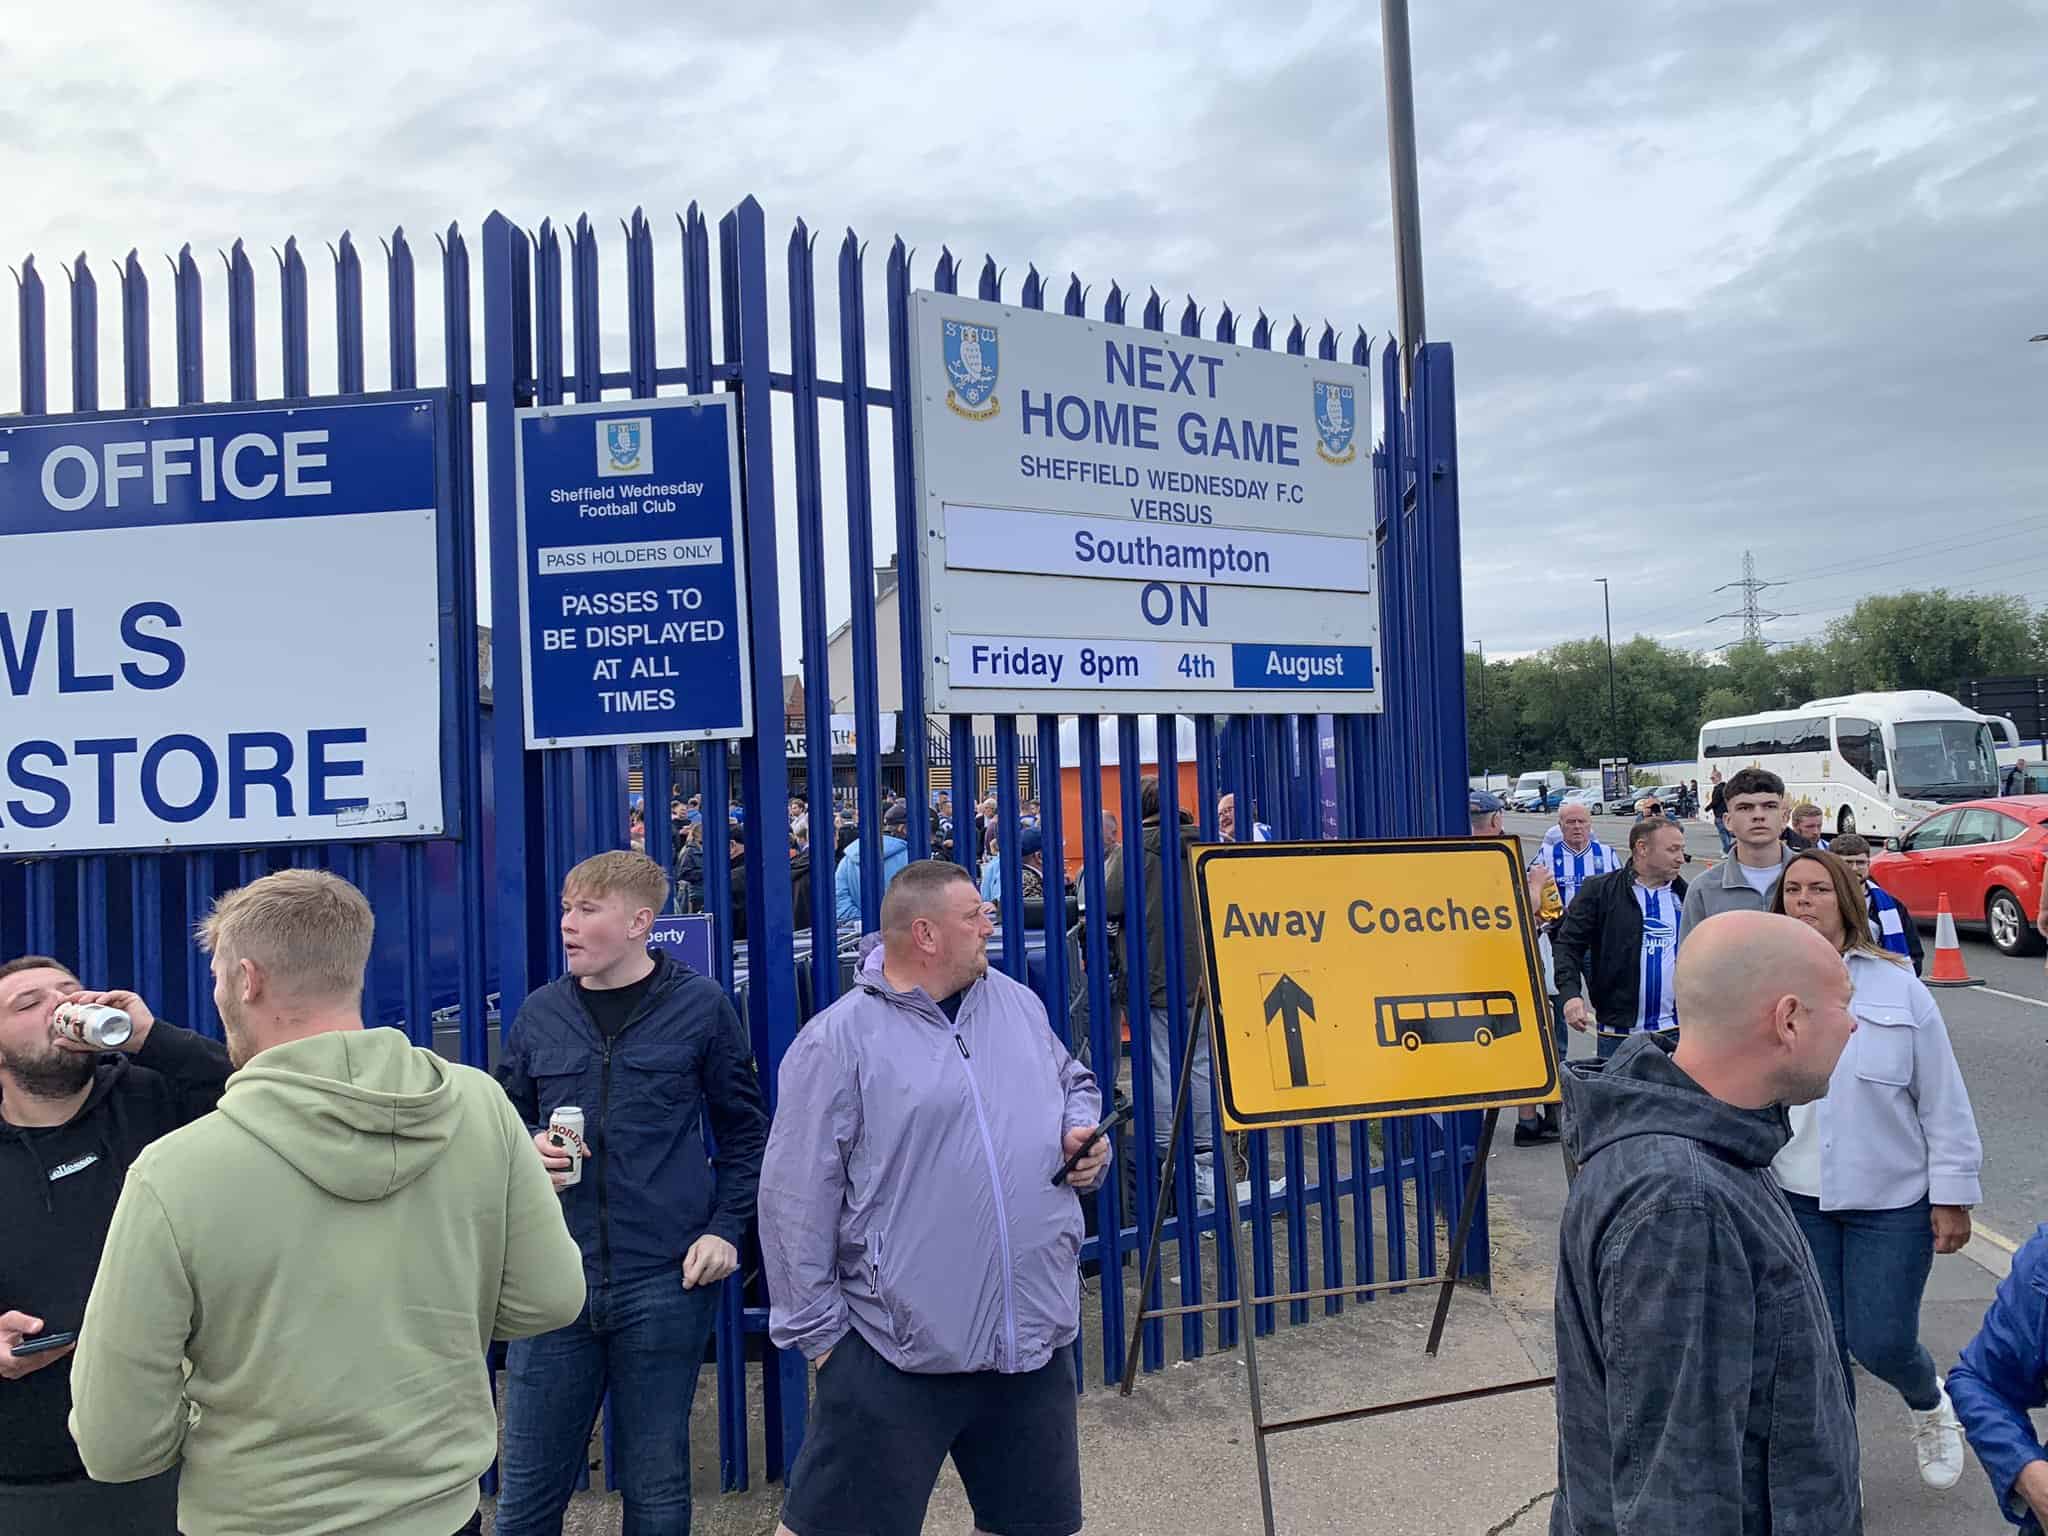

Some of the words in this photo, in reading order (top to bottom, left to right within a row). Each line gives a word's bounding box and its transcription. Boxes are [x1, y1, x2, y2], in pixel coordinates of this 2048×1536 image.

[1105, 340, 1224, 399] NEXT
[1021, 389, 1159, 450] HOME
[1177, 411, 1300, 466] GAME
[41, 430, 332, 511] OFFICE
[1020, 455, 1139, 488] SHEFFIELD
[1148, 469, 1268, 501] WEDNESDAY
[1277, 483, 1303, 504] F.C
[550, 486, 615, 503] Sheffield
[621, 481, 704, 498] Wednesday
[579, 501, 638, 518] Football
[643, 499, 676, 514] Club
[1130, 497, 1213, 525] VERSUS
[546, 553, 587, 567] PASS
[592, 548, 667, 564] HOLDERS
[673, 544, 713, 560] ONLY
[1074, 530, 1270, 577] Southampton
[562, 591, 658, 617] PASSES
[667, 588, 703, 610] TO
[1140, 581, 1209, 627] ON
[543, 628, 577, 651] BE
[586, 620, 724, 648] DISPLAYED
[593, 658, 622, 681] AT
[630, 656, 679, 678] ALL
[971, 645, 1063, 682] Friday
[1080, 647, 1139, 683] 8pm
[1177, 653, 1215, 678] 4th
[1265, 651, 1344, 681] August
[598, 688, 676, 713] TIMES
[0, 727, 369, 828] STORE
[1223, 903, 1326, 943] Away
[1348, 898, 1513, 934] Coaches
